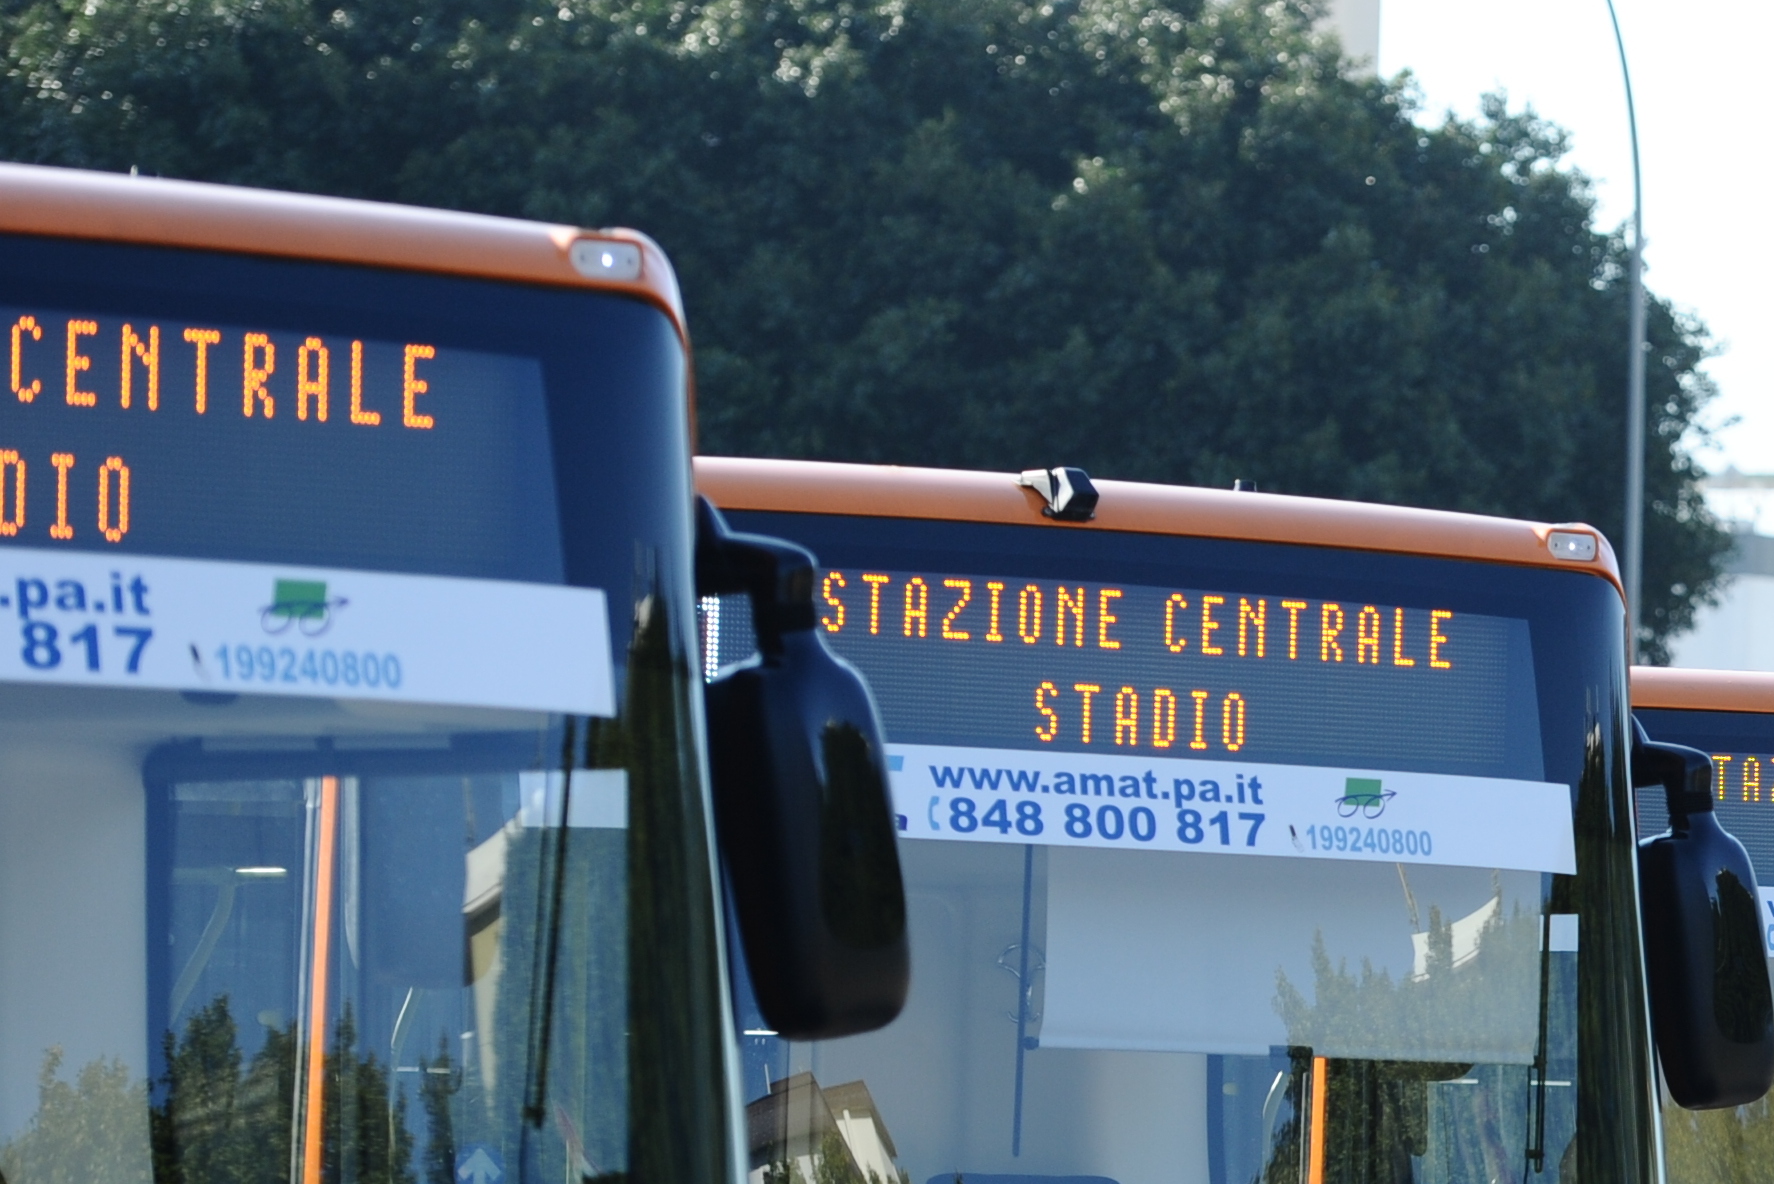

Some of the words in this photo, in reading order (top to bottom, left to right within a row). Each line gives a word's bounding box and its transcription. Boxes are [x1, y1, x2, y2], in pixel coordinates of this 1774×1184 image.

[11, 315, 436, 429] CENTRALE
[820, 570, 1124, 650] STAZIONE
[1164, 592, 1453, 670] CENTRALE
[21, 619, 154, 675] 817
[215, 642, 402, 689] 199240800
[1034, 680, 1246, 753] STADIO
[928, 763, 1264, 808] www.amat.pa.it
[948, 796, 1044, 836] 848
[1063, 802, 1157, 842] 800
[1175, 808, 1267, 847] 817
[1305, 824, 1433, 857] 199240800
